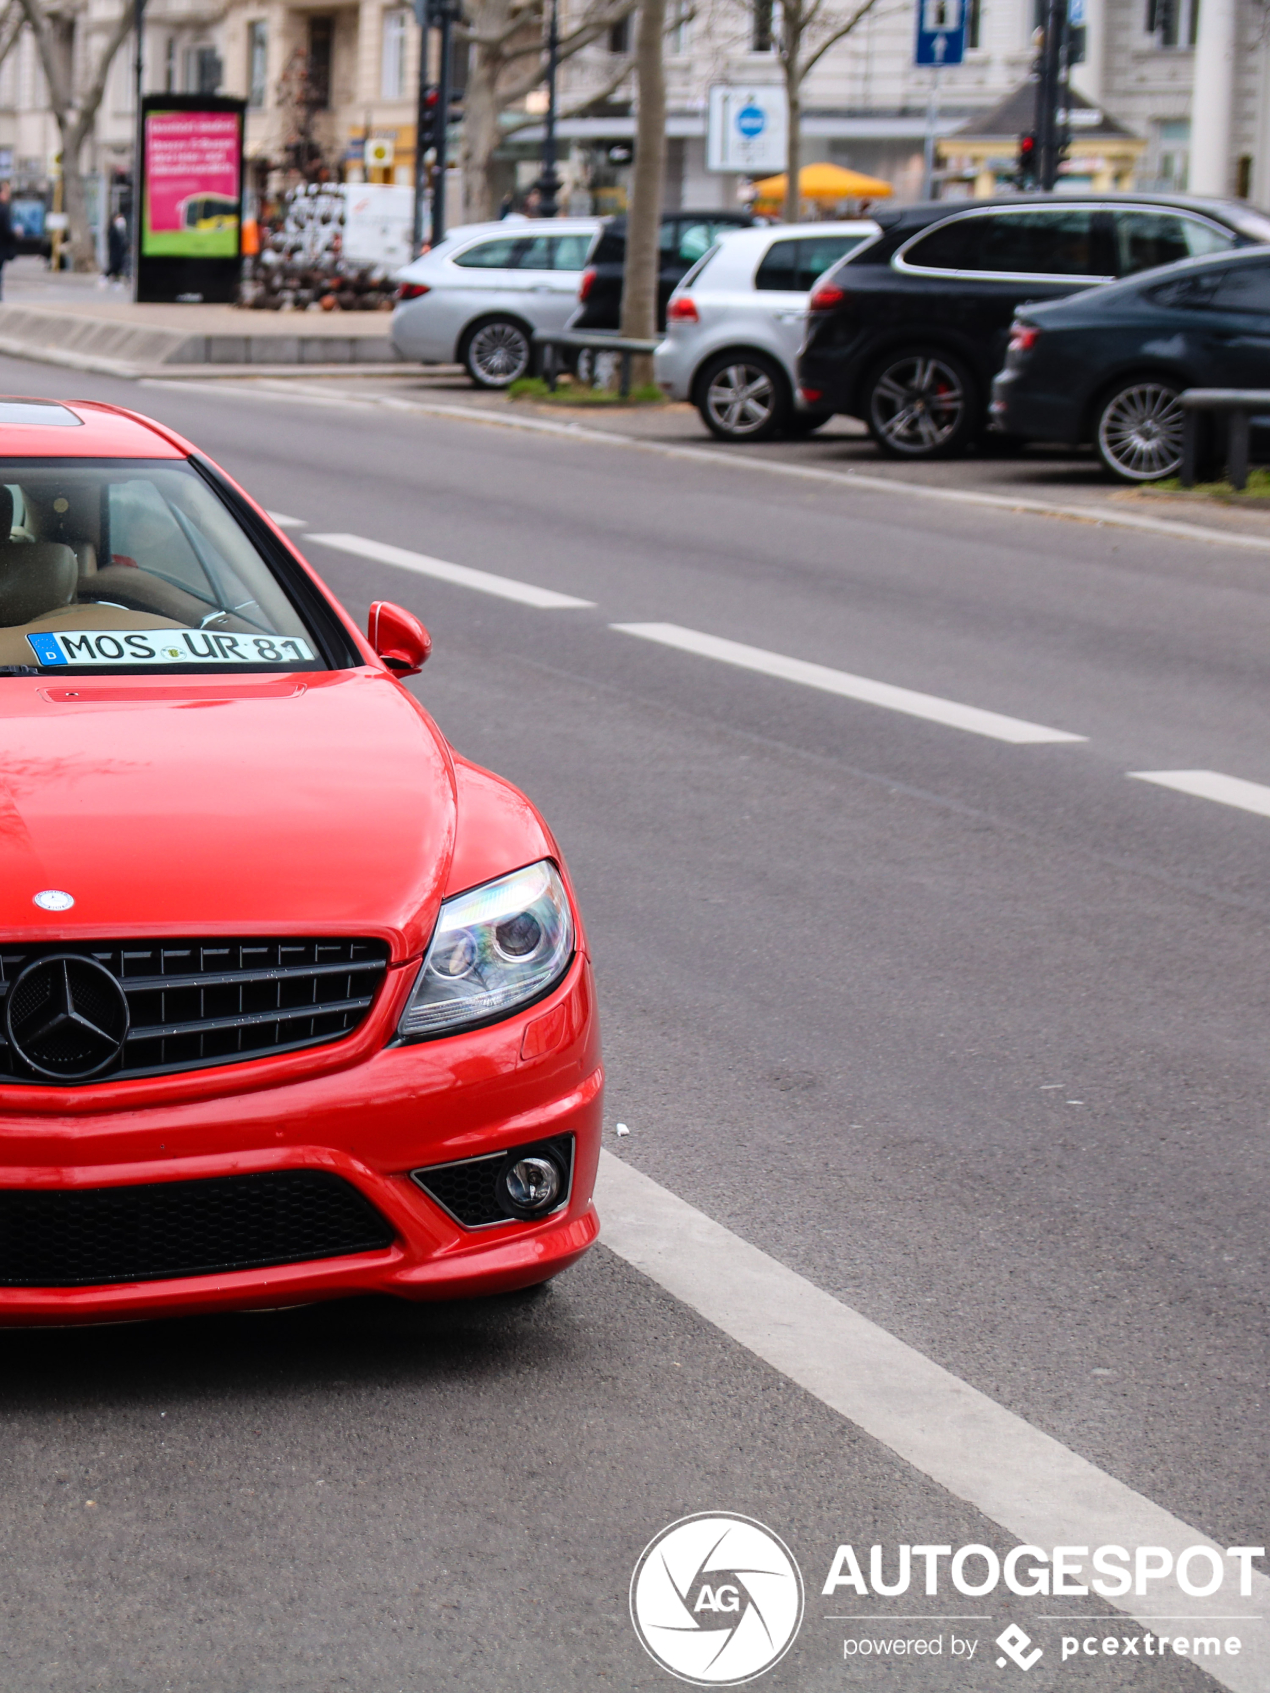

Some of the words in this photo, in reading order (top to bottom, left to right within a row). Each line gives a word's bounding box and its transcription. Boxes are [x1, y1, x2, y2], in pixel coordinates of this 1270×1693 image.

[46, 652, 57, 660] D
[60, 635, 156, 659] MOS
[182, 633, 249, 660] UR
[252, 638, 306, 662] 81
